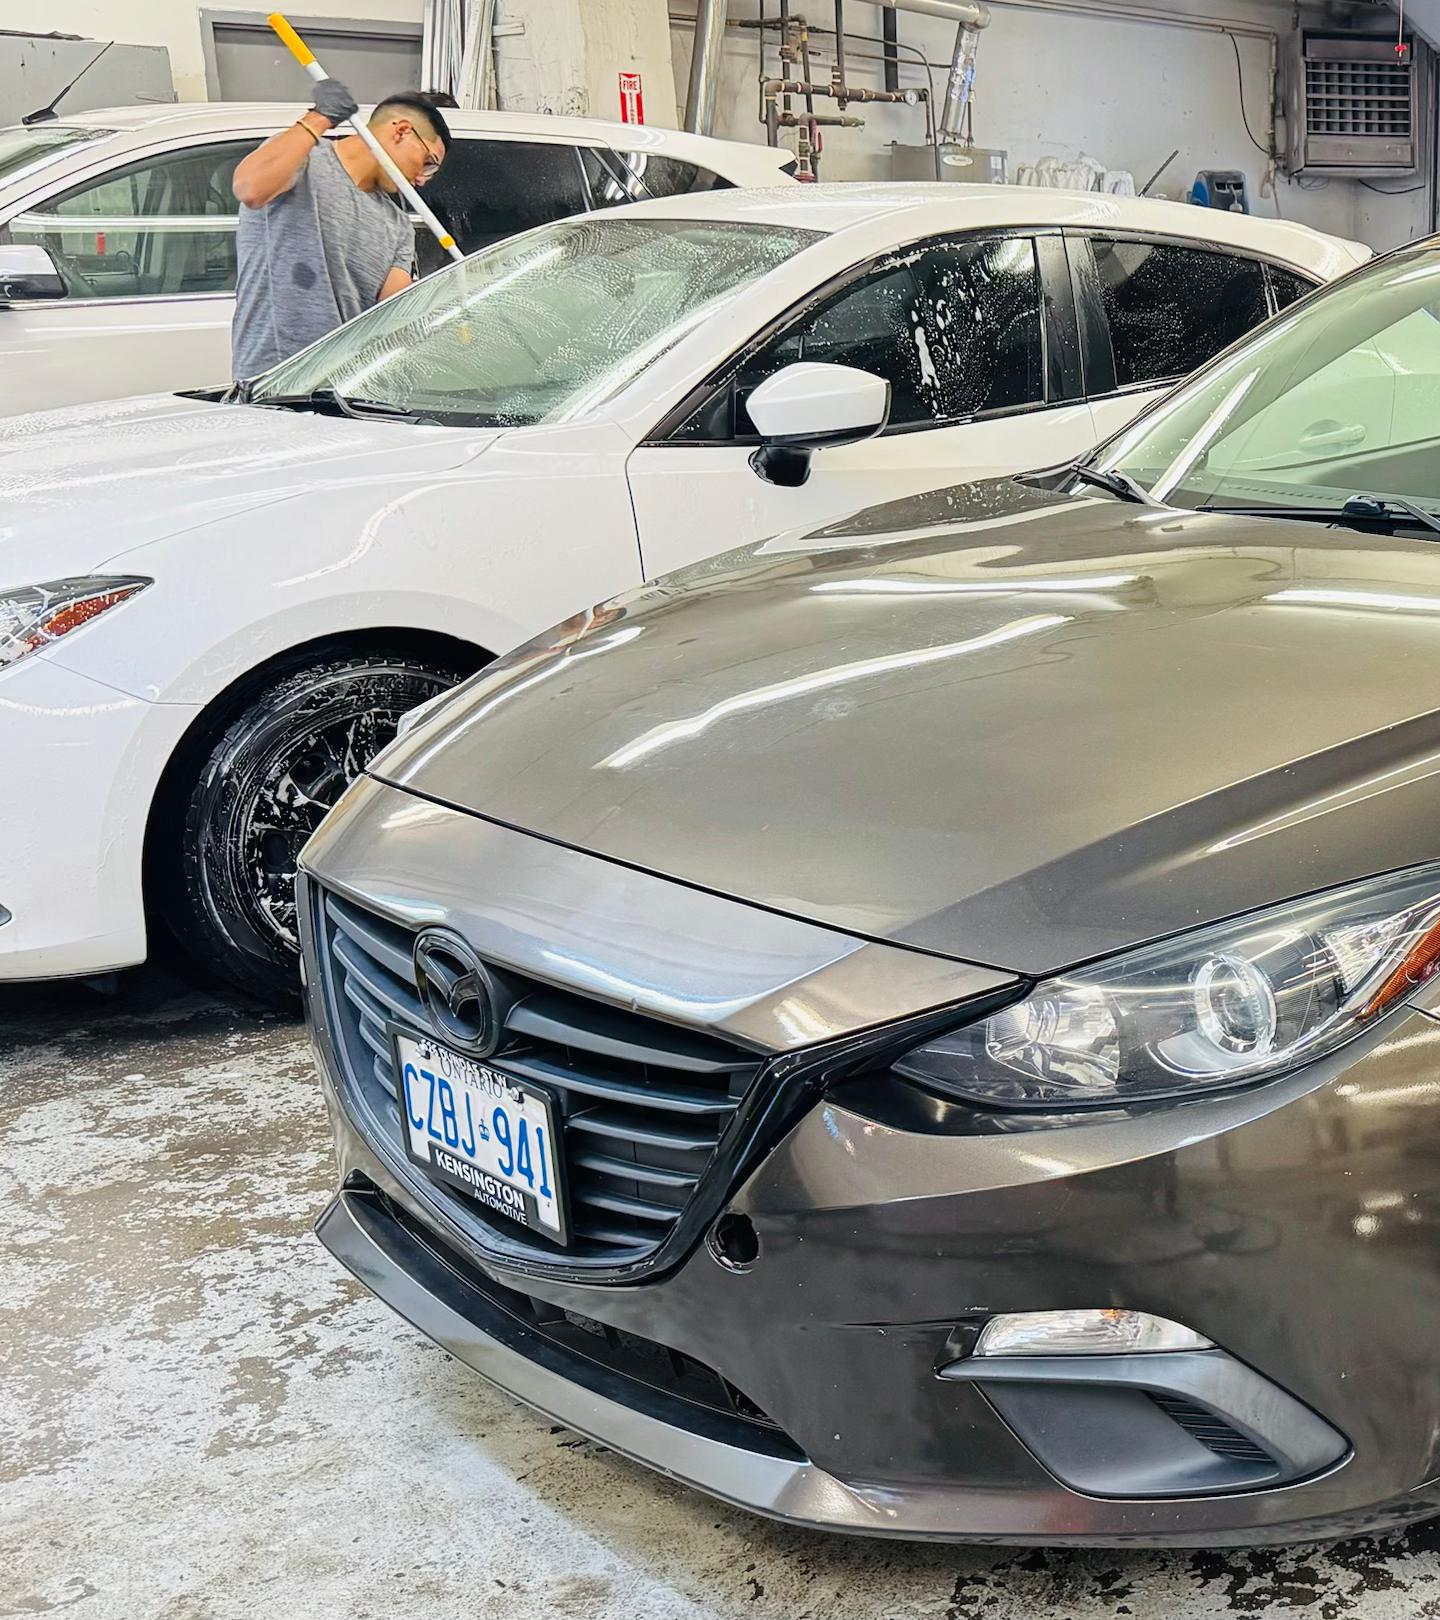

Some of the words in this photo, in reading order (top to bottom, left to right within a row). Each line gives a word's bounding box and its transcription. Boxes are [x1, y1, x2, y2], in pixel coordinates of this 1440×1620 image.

[622, 80, 638, 91] FIRE
[404, 1063, 476, 1158] CZBJ
[492, 1106, 552, 1199] 941
[435, 1149, 525, 1212] KENSINGTON
[474, 1188, 528, 1226] AUTOMOTIVE
